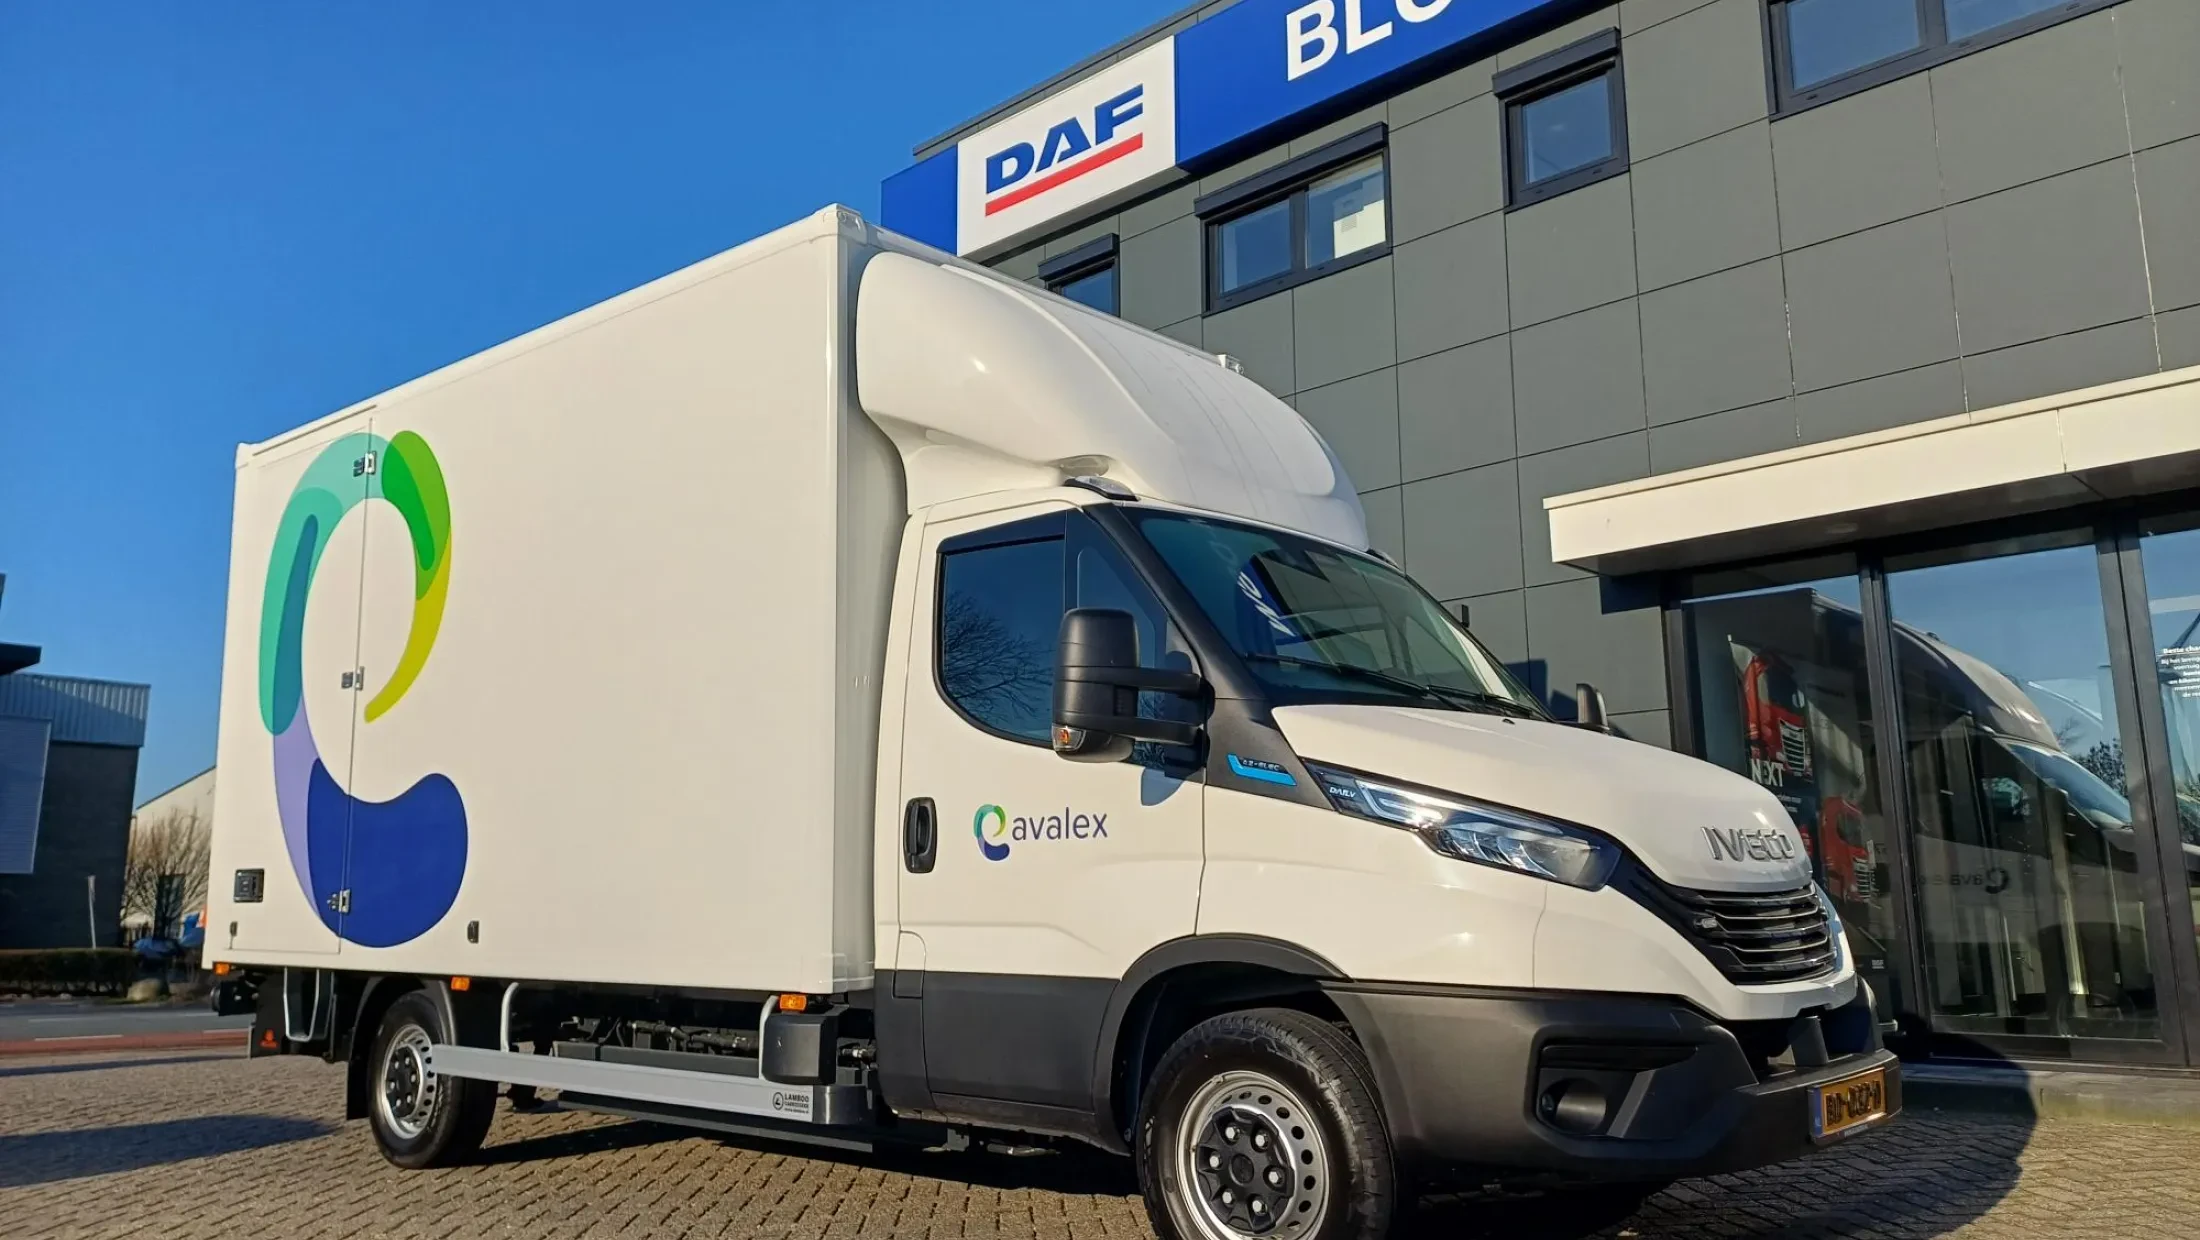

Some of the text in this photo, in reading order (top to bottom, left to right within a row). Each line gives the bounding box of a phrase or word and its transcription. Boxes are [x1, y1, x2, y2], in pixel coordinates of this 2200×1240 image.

[985, 83, 1144, 194] DAF
[1329, 786, 1356, 798] DAILY
[1012, 806, 1108, 841] avalex
[1700, 826, 1795, 862] IVECO
